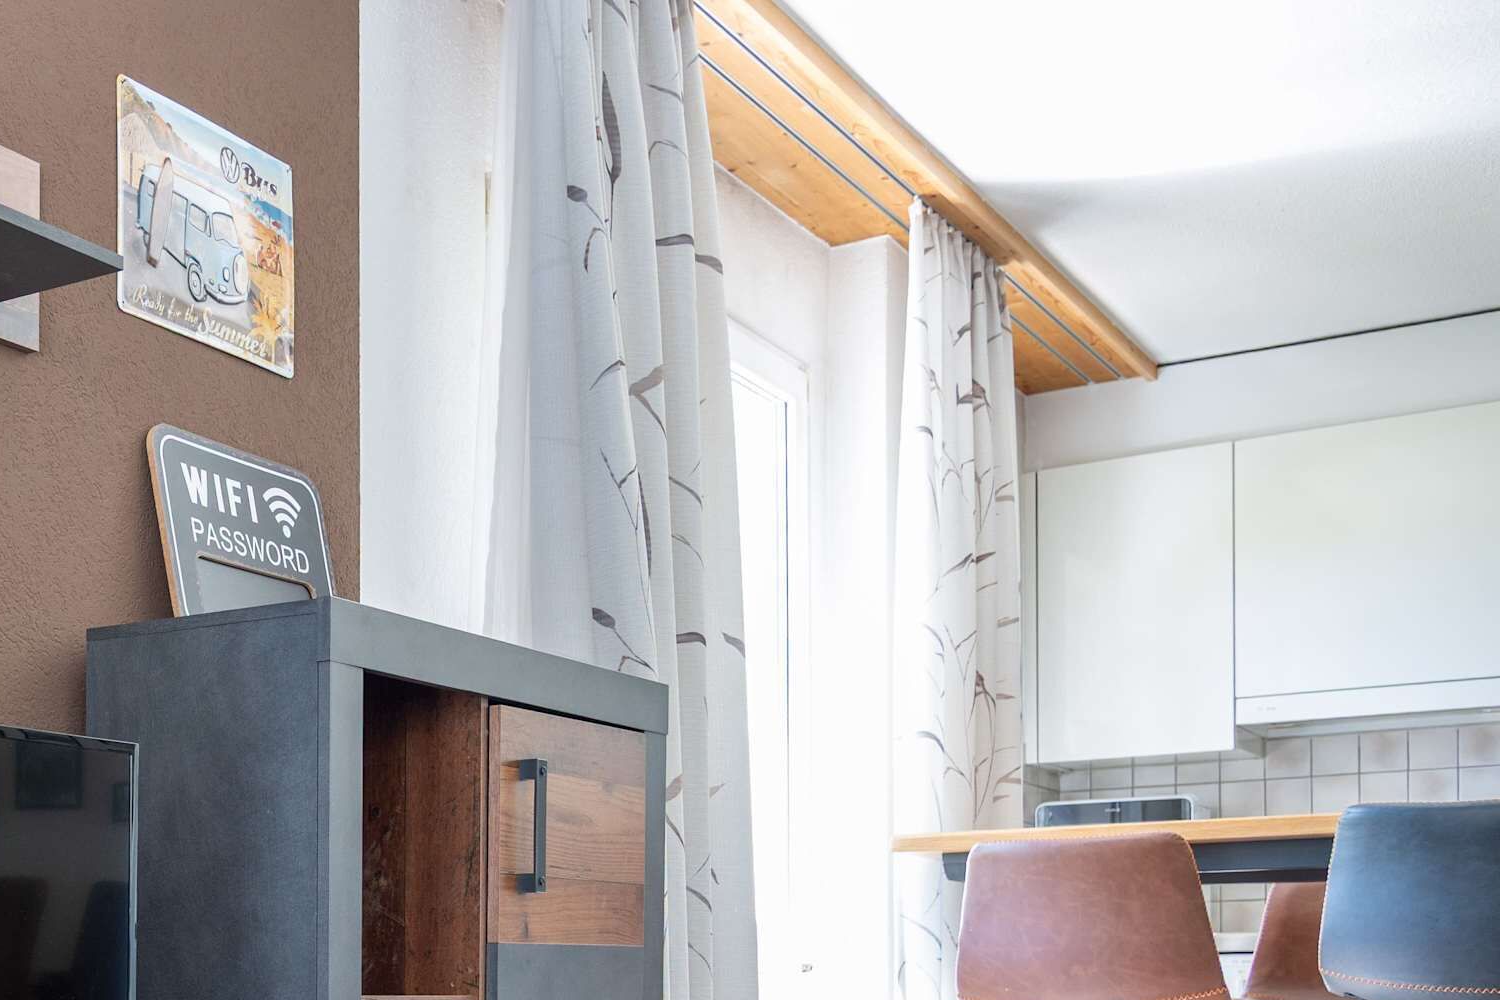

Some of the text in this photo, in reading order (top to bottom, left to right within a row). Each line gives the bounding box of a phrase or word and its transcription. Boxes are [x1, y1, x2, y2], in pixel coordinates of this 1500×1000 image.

[132, 284, 165, 316] Ready
[184, 303, 199, 324] the
[196, 307, 269, 358] Summer
[180, 462, 259, 524] WIFI
[190, 517, 310, 574] PASSWORD
